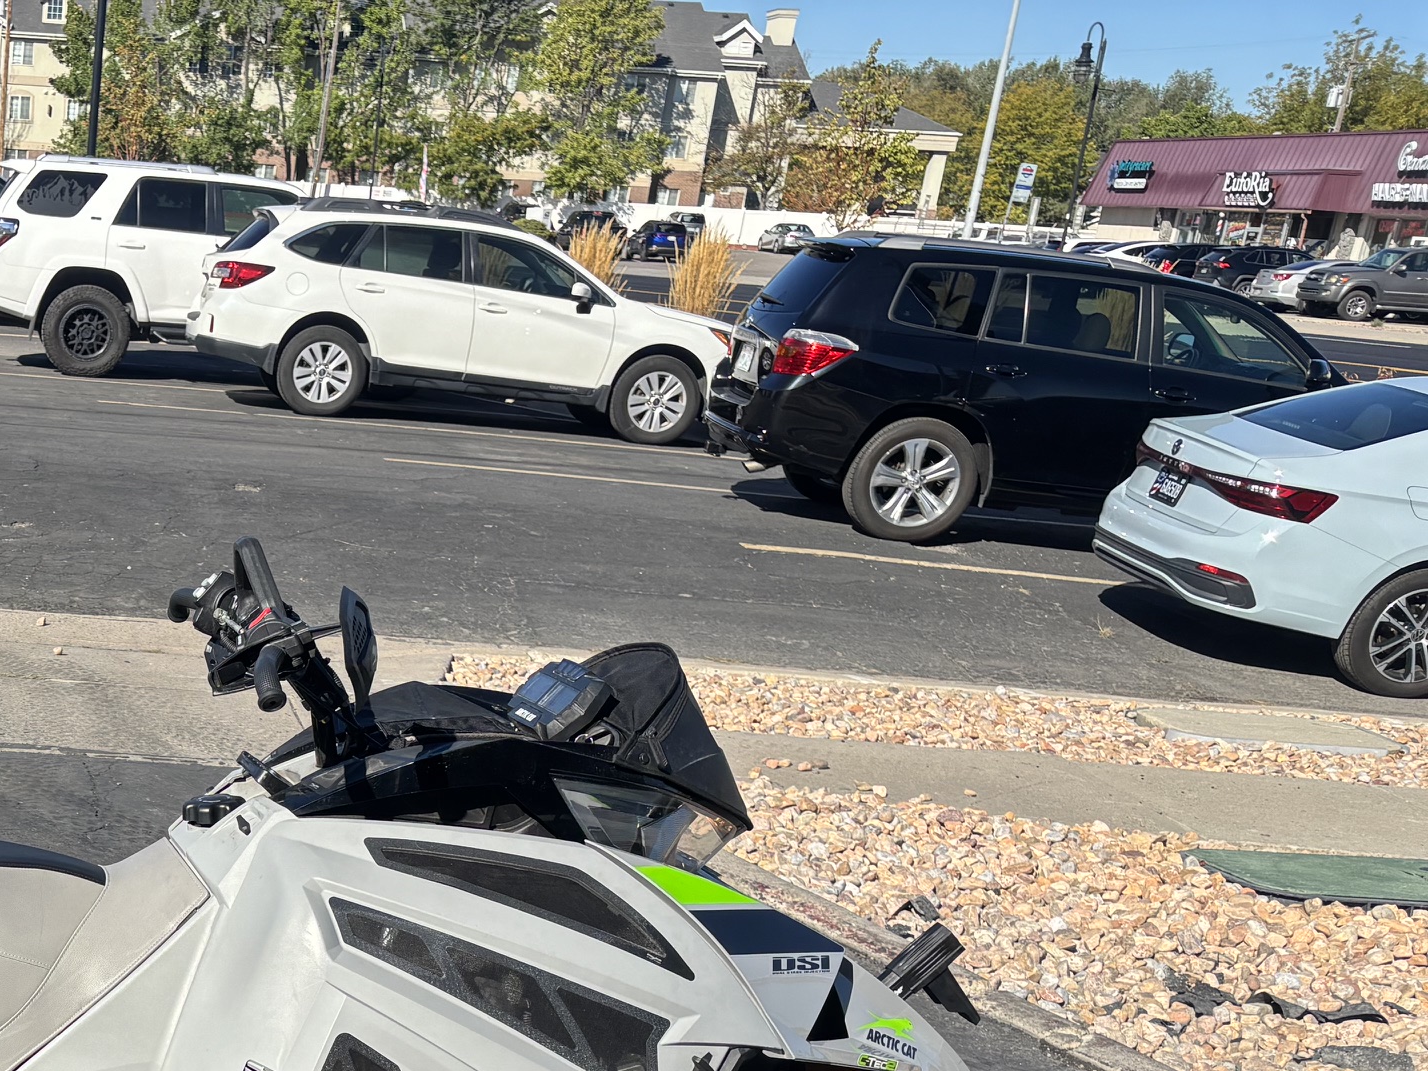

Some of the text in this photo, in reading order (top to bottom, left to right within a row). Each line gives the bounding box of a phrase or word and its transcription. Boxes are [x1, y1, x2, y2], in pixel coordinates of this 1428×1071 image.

[772, 955, 830, 971] DSI
[866, 1028, 900, 1053] ARCTIC
[901, 1042, 918, 1060] CAT
